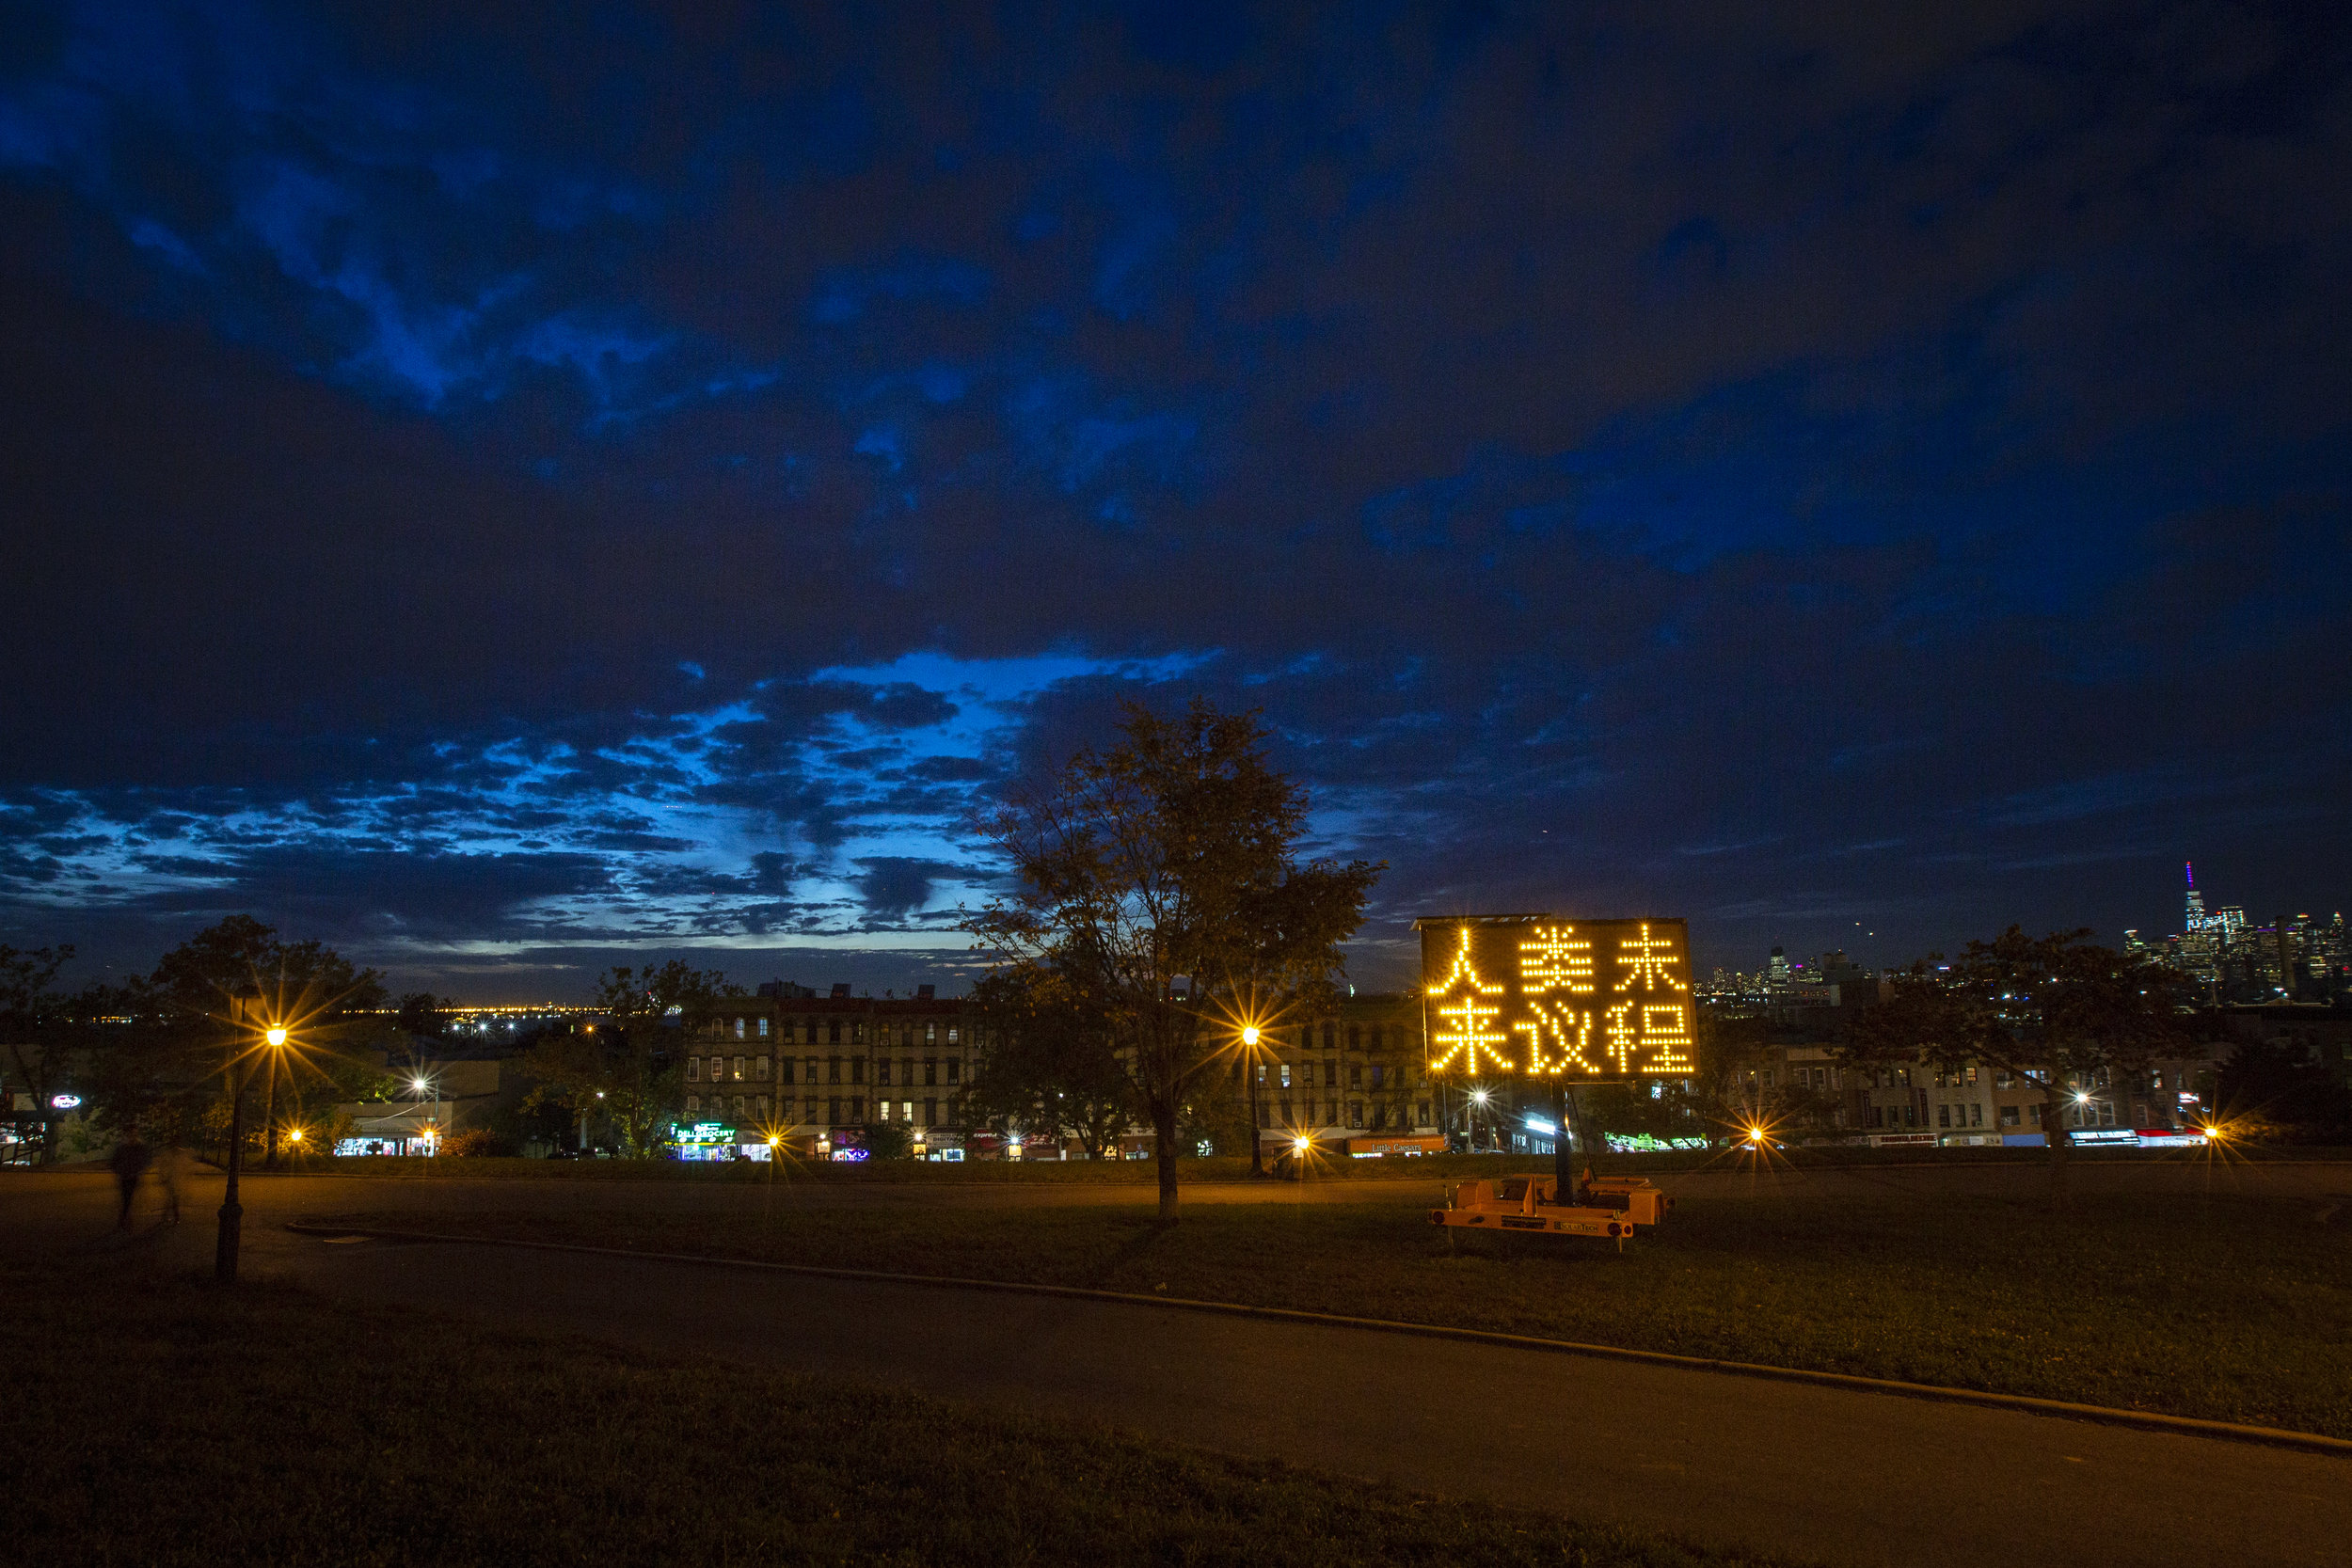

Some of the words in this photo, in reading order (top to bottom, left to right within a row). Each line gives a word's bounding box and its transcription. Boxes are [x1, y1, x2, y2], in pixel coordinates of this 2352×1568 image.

[1427, 924, 1689, 993] 人类未
[1431, 997, 1695, 1074] 来议程
[1372, 1144, 1391, 1152] Little
